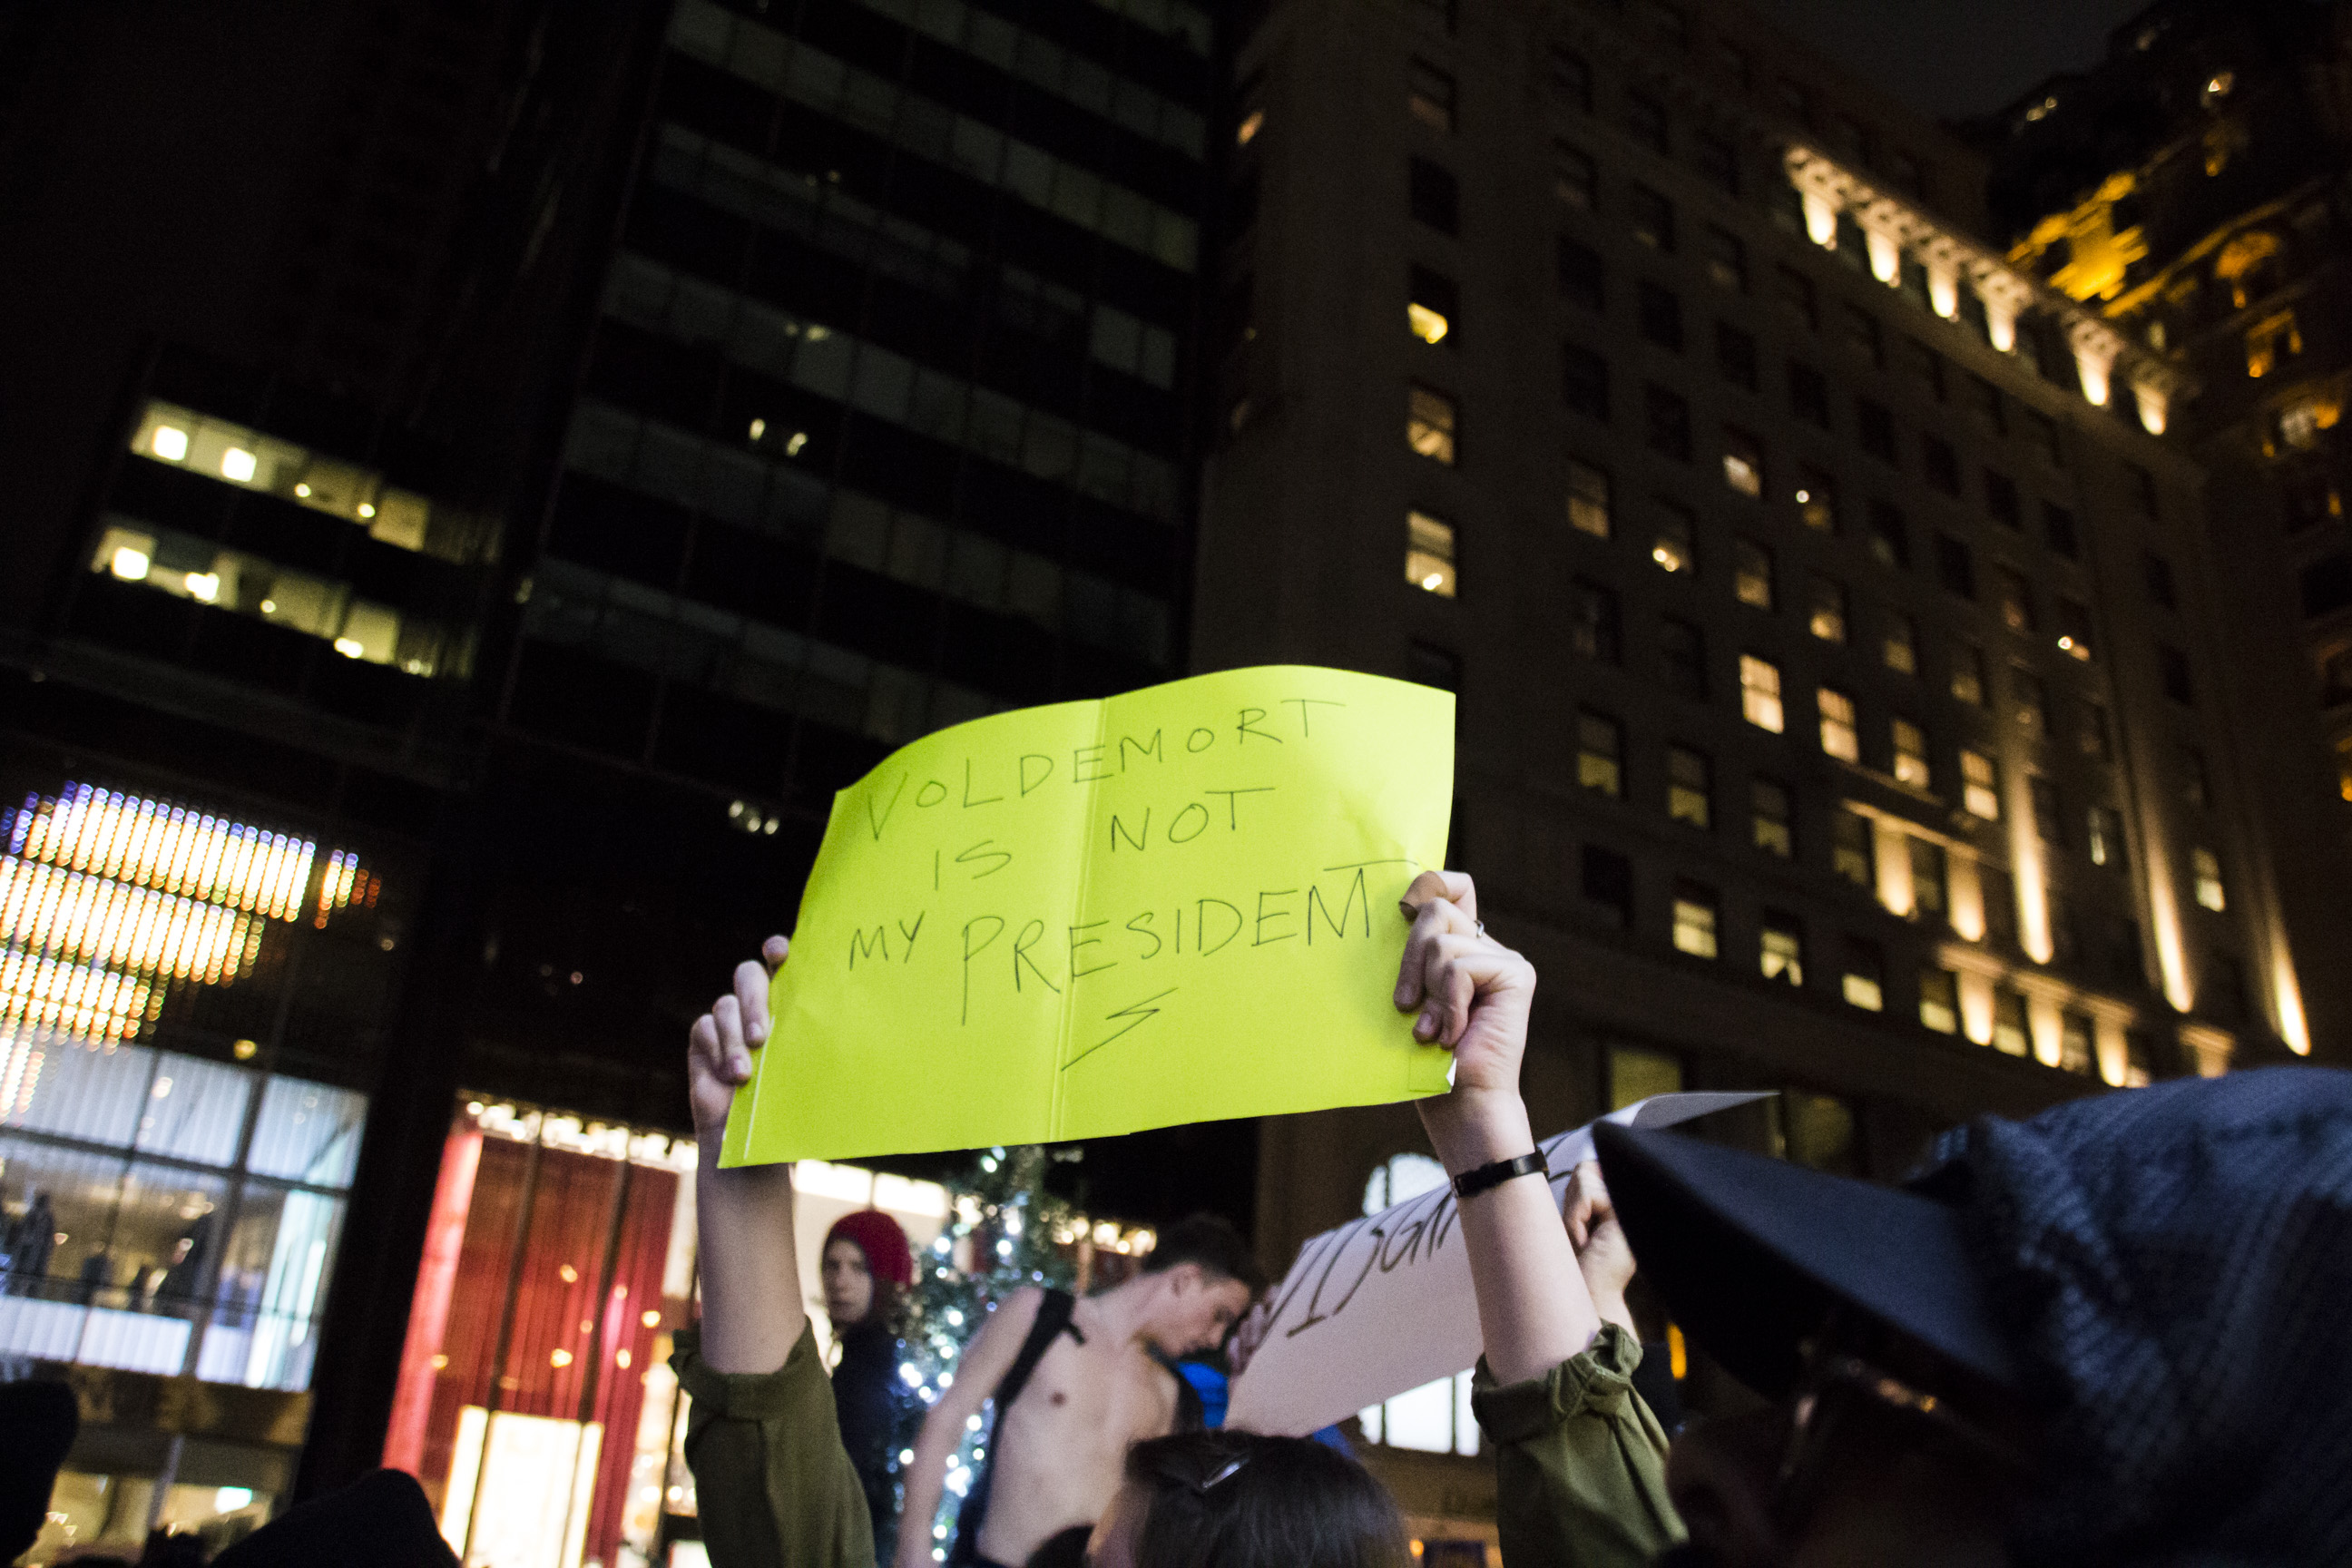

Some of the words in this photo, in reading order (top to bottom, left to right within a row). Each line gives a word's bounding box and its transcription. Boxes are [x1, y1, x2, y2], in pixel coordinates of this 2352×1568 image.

[867, 699, 1347, 841] VOLDEMORT
[935, 839, 1013, 891] IS
[1111, 786, 1277, 853] NOT
[848, 910, 926, 972] MY
[961, 858, 1419, 1027] PRESIDENT
